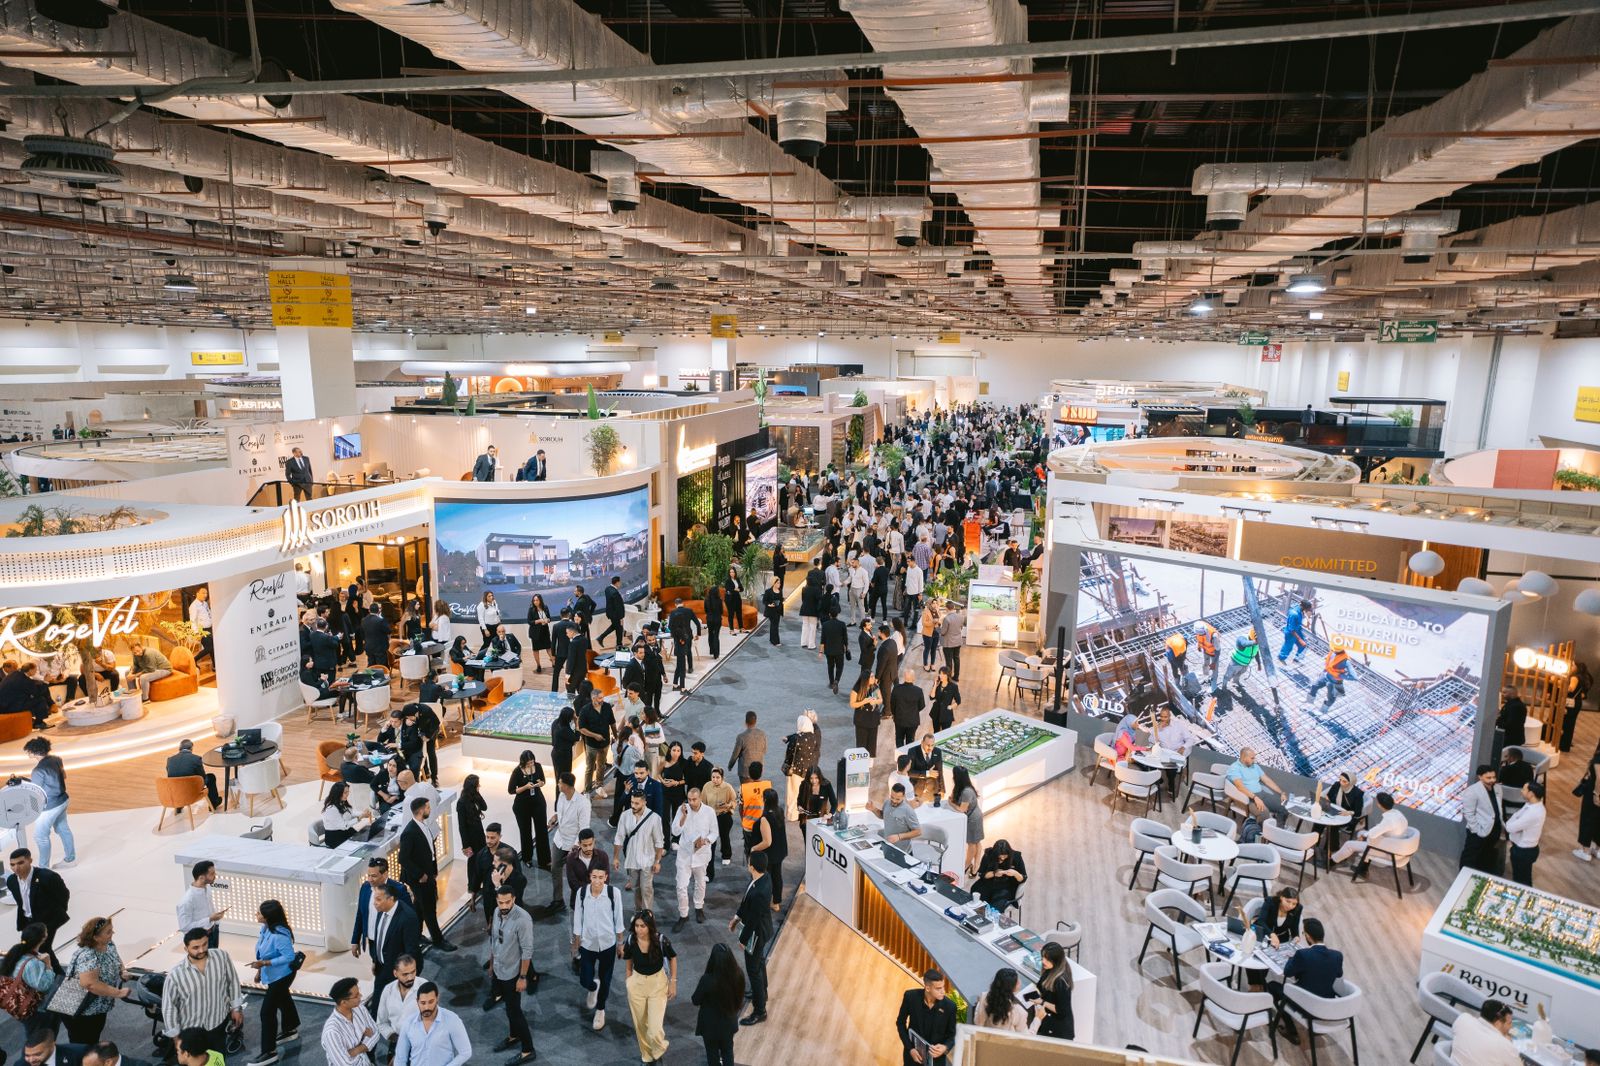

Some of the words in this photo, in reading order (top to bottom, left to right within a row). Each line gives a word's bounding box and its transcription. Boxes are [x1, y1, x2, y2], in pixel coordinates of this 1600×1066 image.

[310, 500, 382, 532] SOROUH
[318, 521, 385, 544] DEVELOPMENTS
[1279, 556, 1378, 573] COMMITTED
[0, 596, 140, 658] RoseVil
[250, 614, 293, 635] ENTRADA
[1338, 608, 1418, 630] DEDICATED
[1422, 621, 1445, 635] TO
[1336, 623, 1420, 646] DELIVERING
[268, 640, 297, 655] CITADEL
[1333, 636, 1354, 649] ON
[1359, 640, 1393, 656] TIME
[274, 662, 298, 676] Entrada
[1099, 698, 1125, 714] TLD
[826, 843, 848, 869] TLD
